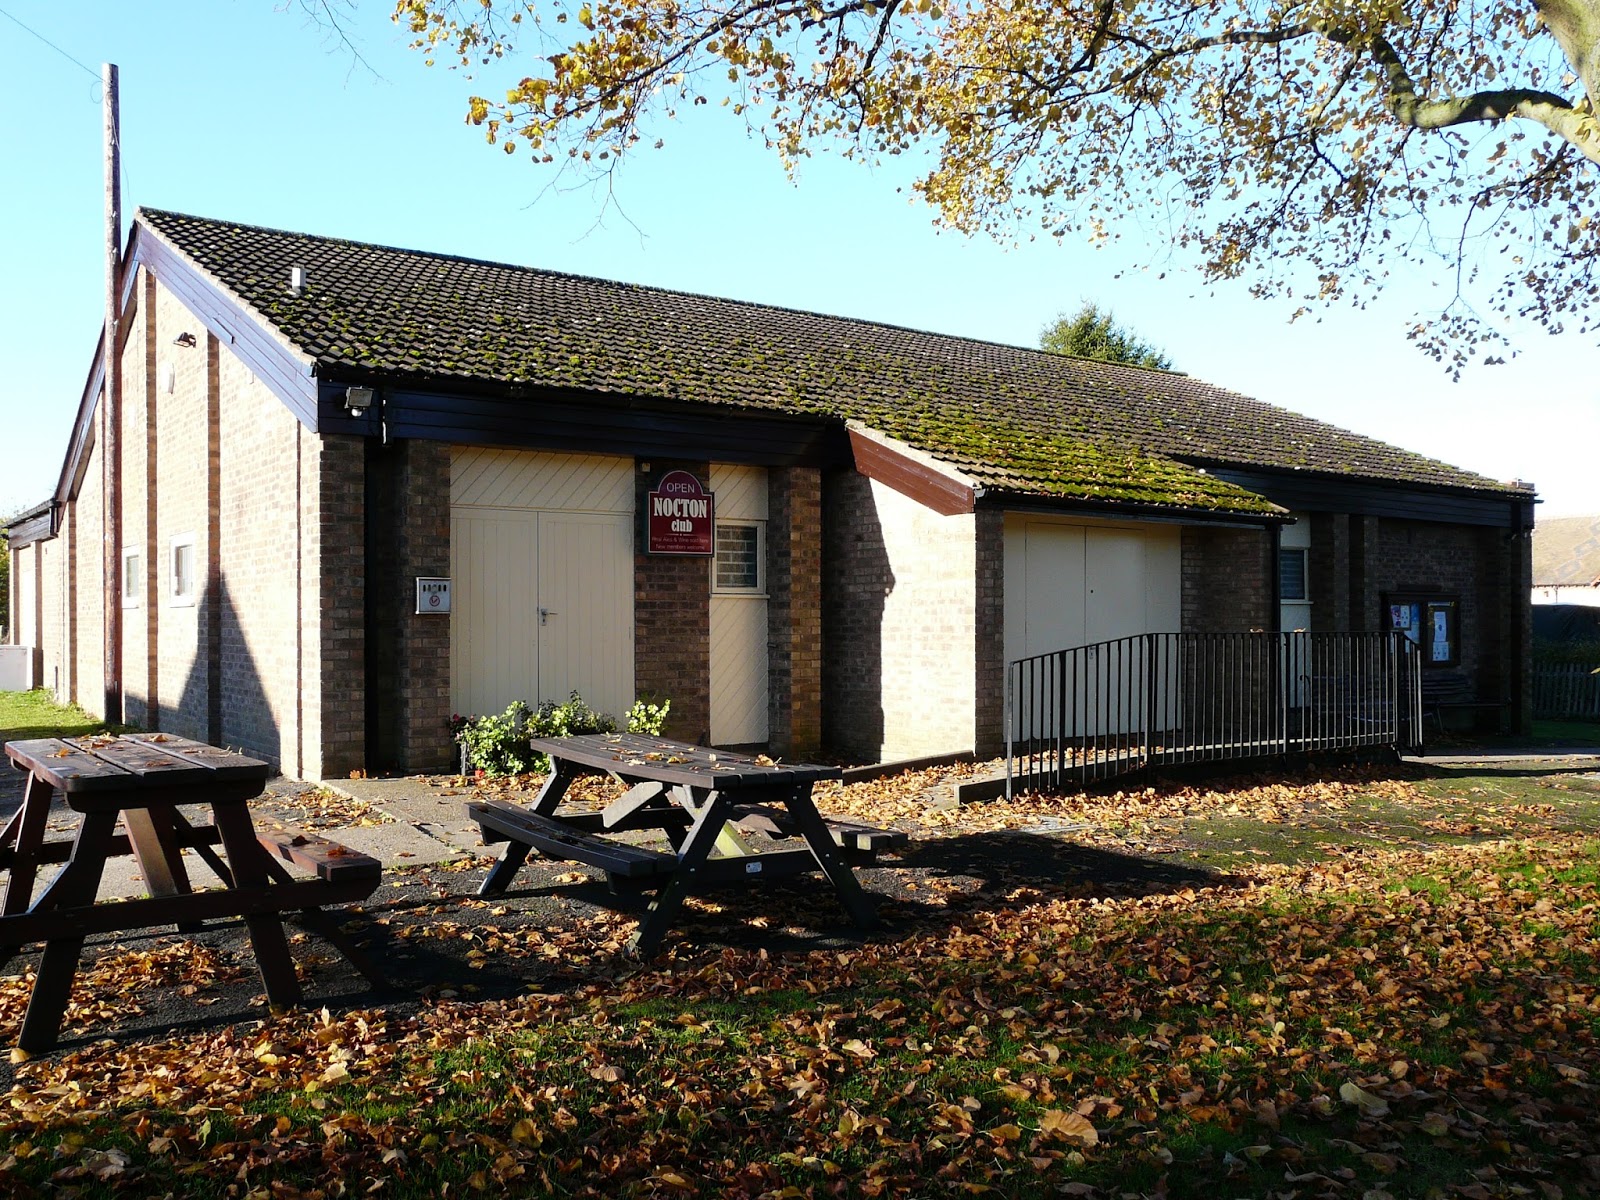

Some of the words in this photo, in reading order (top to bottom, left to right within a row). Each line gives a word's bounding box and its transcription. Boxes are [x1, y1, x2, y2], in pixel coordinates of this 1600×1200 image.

[666, 482, 695, 493] OPEN
[653, 497, 708, 518] NOCTON
[671, 519, 693, 532] club
